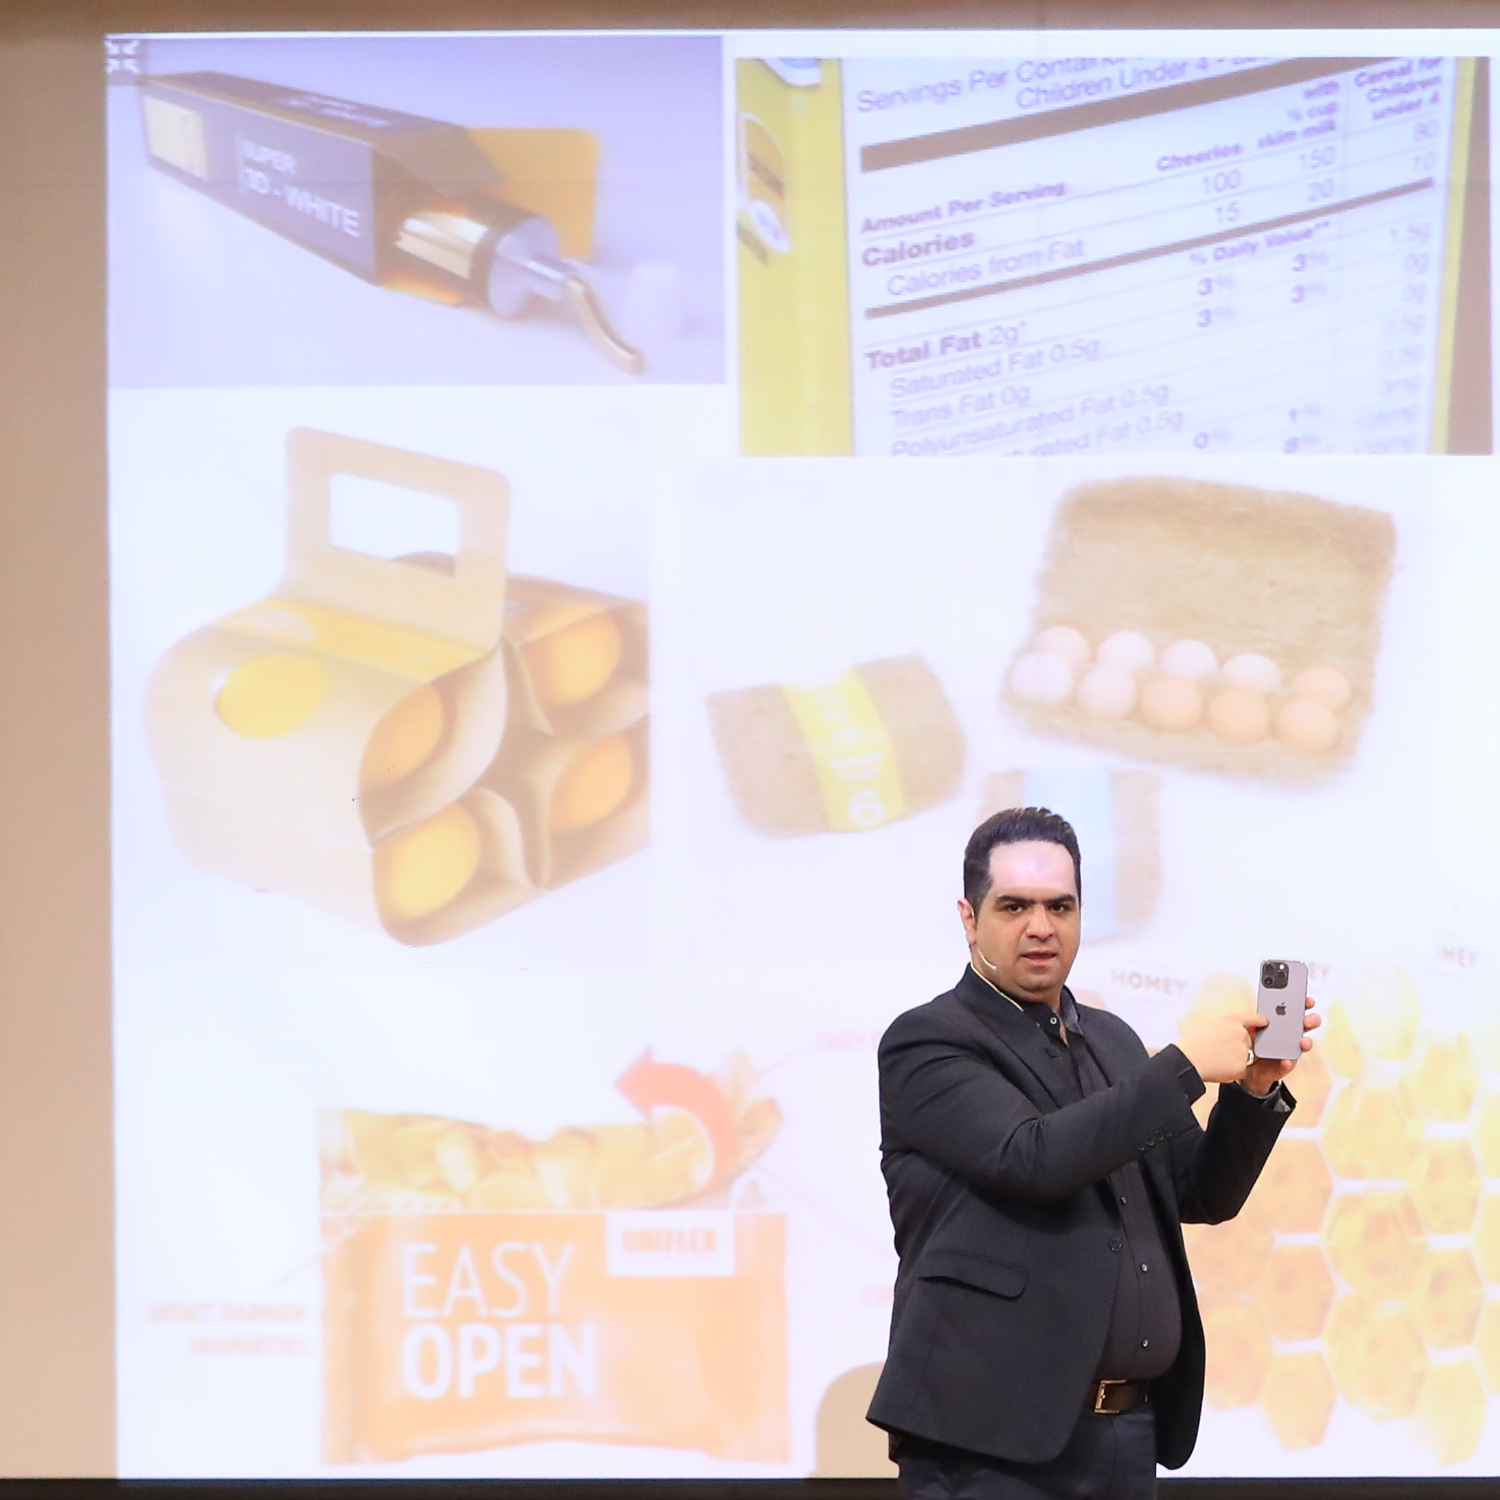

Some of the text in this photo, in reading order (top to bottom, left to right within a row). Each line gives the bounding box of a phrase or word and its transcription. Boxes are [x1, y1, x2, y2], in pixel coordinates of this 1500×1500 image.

[1015, 76, 1112, 109] Children
[1118, 59, 1188, 89] Under
[1302, 81, 1340, 100] with
[1353, 59, 1414, 88] Cereal
[1366, 75, 1442, 104] Children
[857, 79, 963, 113] Servings
[968, 70, 1010, 93] Per
[1306, 101, 1339, 119] cup
[1256, 118, 1337, 149] skim milk
[1155, 142, 1244, 173] Cheerios
[1297, 144, 1338, 172] 150
[1201, 168, 1243, 196] 100
[1306, 177, 1336, 203] 20
[284, 184, 361, 239] WHITE
[861, 180, 1069, 234] Amount Per Serving
[1214, 200, 1242, 224] 15
[861, 231, 977, 268] Calories
[1212, 241, 1260, 263] Daily
[885, 237, 1086, 298] Calories from Fat
[863, 339, 931, 371] Total
[938, 330, 983, 357] Fat
[889, 337, 1101, 400] Saturated Fat 0.5g
[889, 385, 1032, 428] Trans Fat 0g
[890, 403, 1075, 458] Polyunsaturated
[1079, 394, 1116, 418] Fat
[1119, 384, 1171, 408] 0.5g
[1096, 419, 1131, 444] Fat
[1136, 410, 1185, 434] 0.5g
[847, 788, 885, 828] 6
[1110, 967, 1187, 998] HOMEY
[402, 1240, 576, 1319] EASY
[400, 1321, 599, 1401] OPEN
